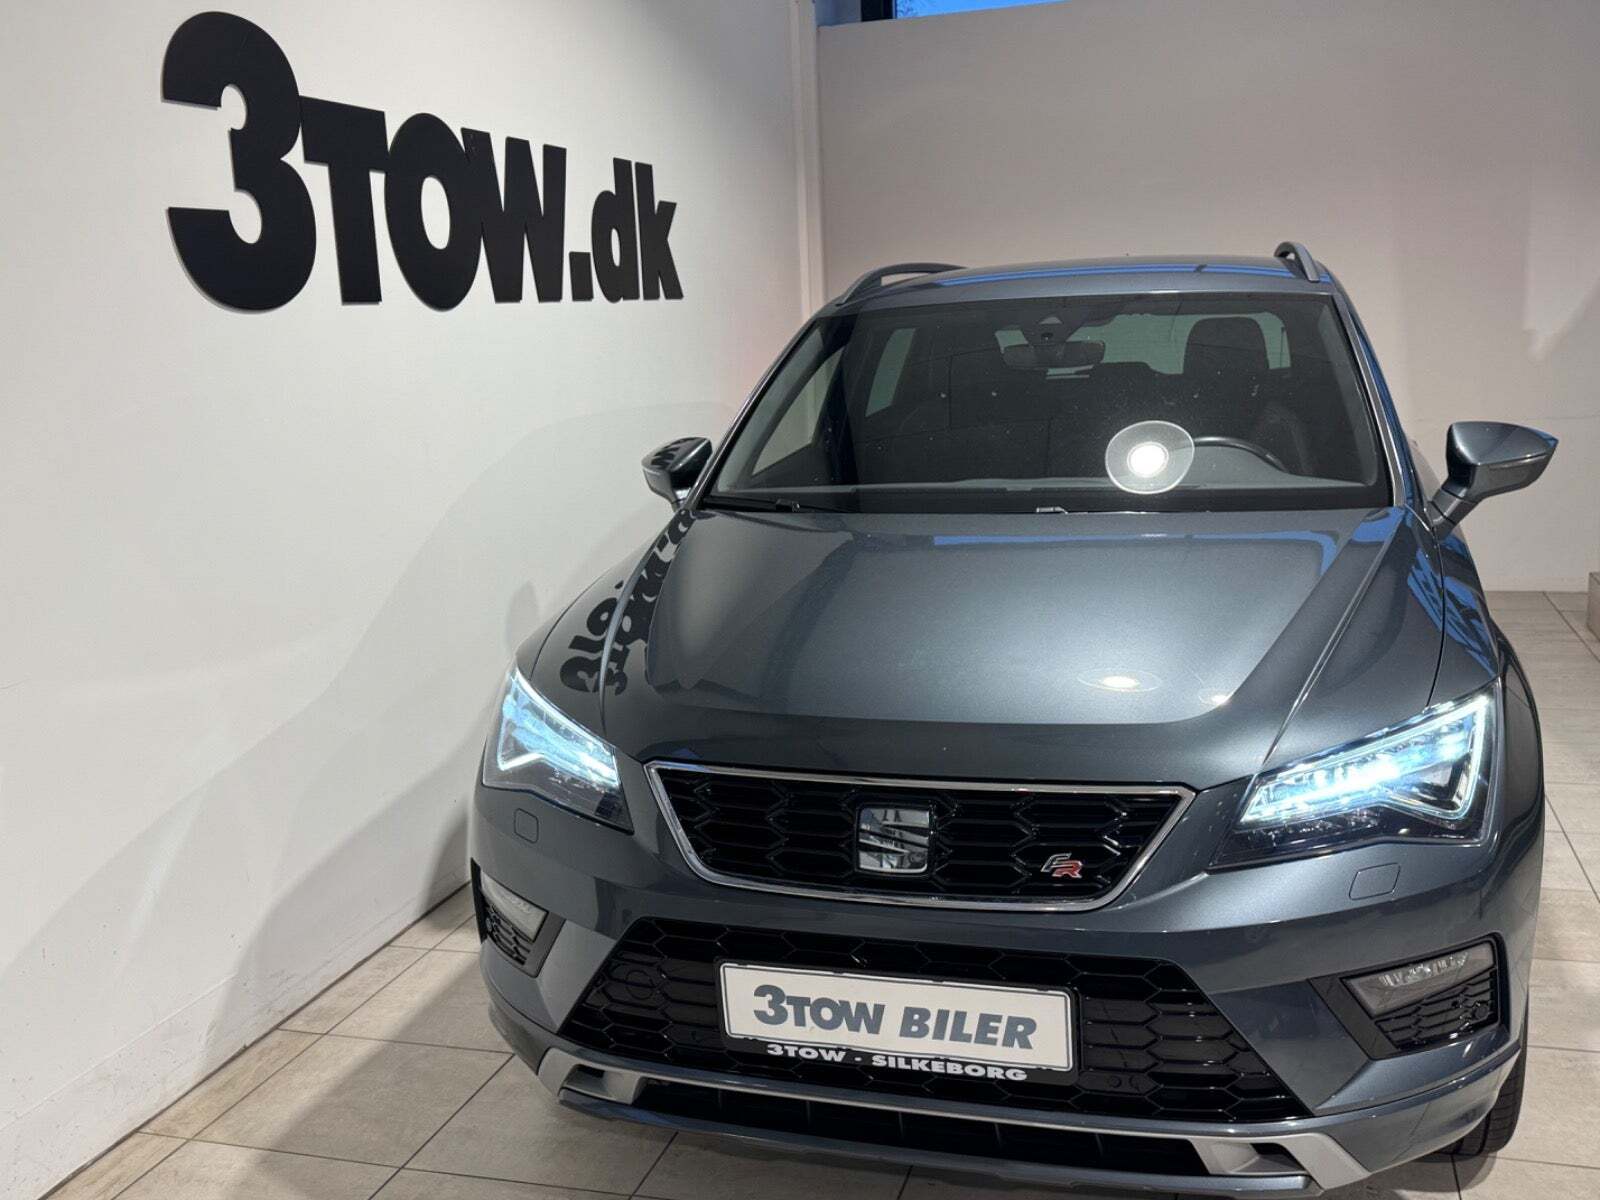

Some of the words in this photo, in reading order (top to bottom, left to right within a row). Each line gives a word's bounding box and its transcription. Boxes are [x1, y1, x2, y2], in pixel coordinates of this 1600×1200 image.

[161, 11, 684, 313] 3TOW.dk
[753, 984, 885, 1035] 3TOW
[899, 1006, 1037, 1049] BILER
[767, 1044, 845, 1062] 3TOW
[871, 1055, 1027, 1081] SILKEBORG
